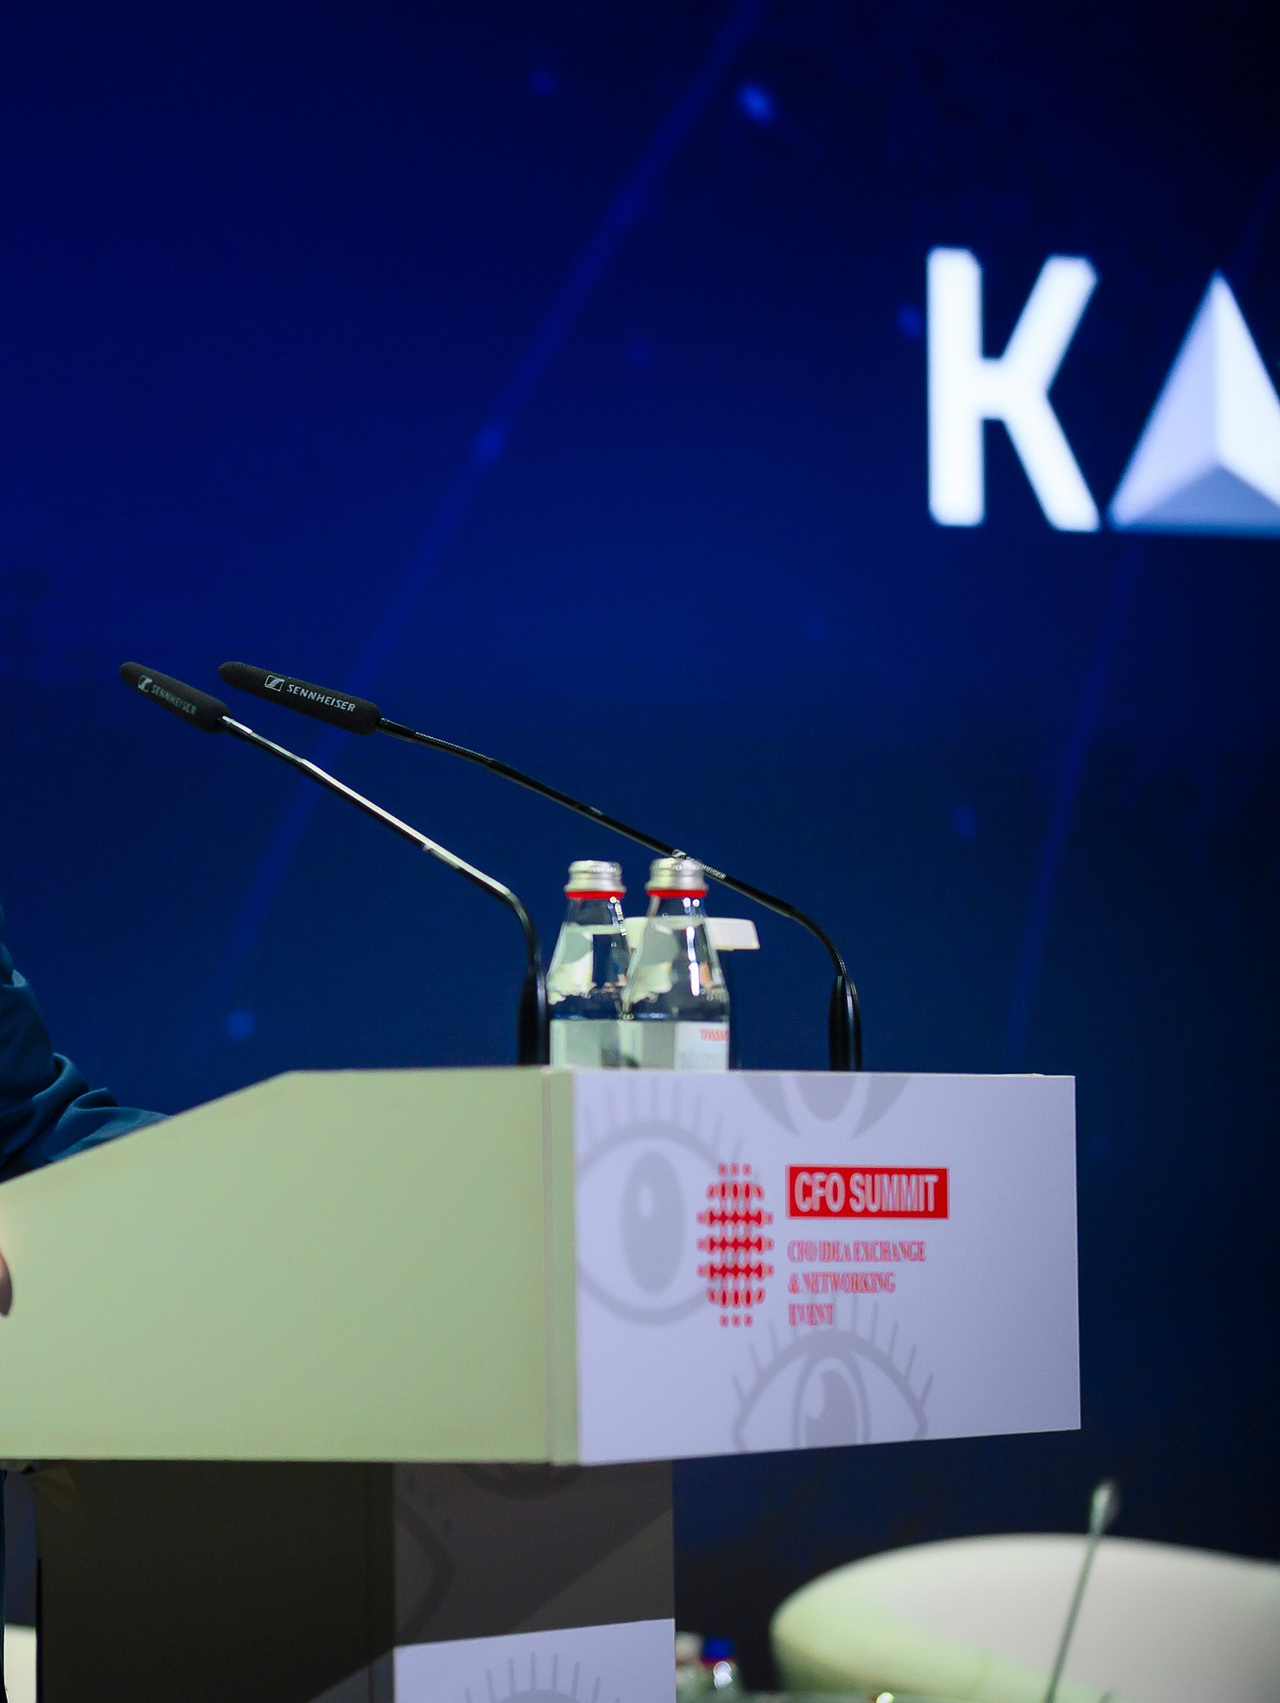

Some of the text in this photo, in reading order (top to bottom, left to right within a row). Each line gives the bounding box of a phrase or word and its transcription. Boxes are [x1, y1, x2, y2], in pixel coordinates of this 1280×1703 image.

[287, 684, 356, 712] SENNHEISER
[794, 1171, 939, 1213] CFO SUMMIT
[787, 1240, 927, 1263] CFO IDEA EXCHANGE
[788, 1271, 896, 1294] & NETWORKING
[788, 1303, 834, 1326] EVENT
